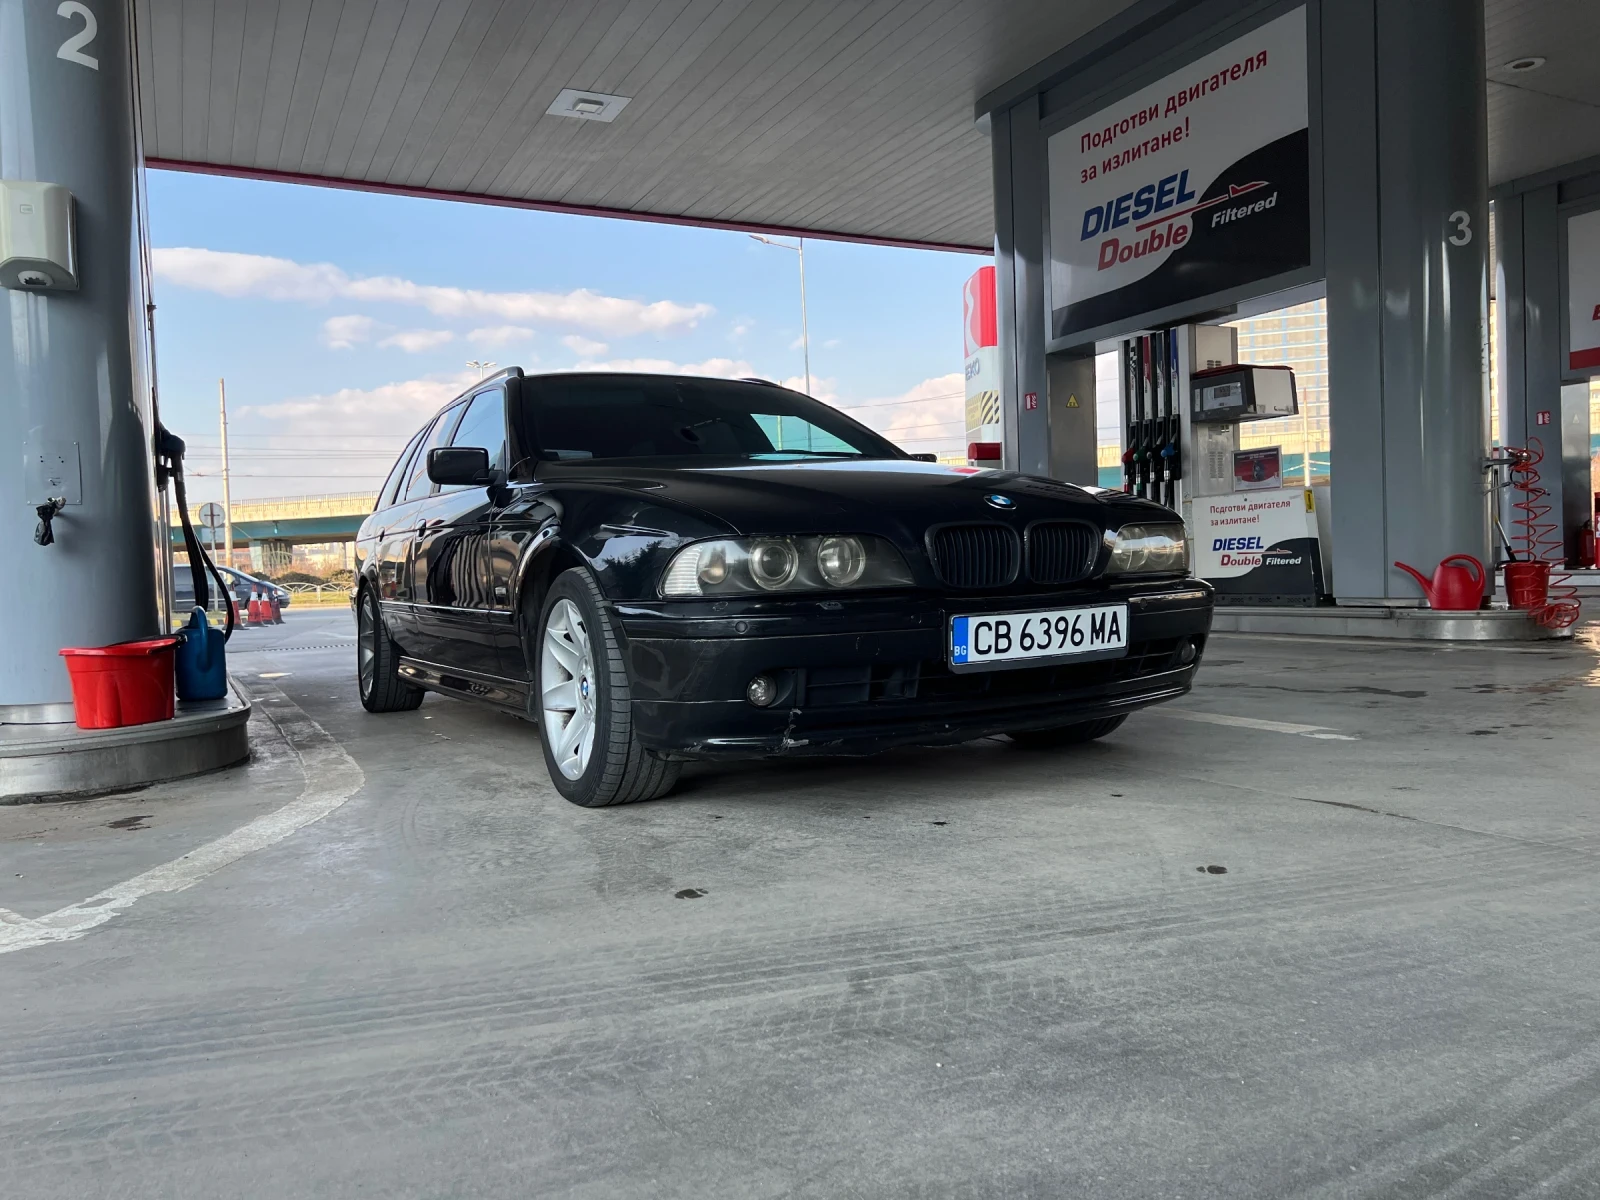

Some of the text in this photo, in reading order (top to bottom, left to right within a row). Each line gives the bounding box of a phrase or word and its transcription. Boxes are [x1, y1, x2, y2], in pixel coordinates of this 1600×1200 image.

[57, 1, 98, 70] 2
[1081, 50, 1268, 153] Подготви двигателя
[1081, 117, 1190, 184] за излитане!
[1080, 169, 1196, 241] DIESEL
[1097, 191, 1278, 271] Double Filtered
[1448, 210, 1472, 246] 3
[1220, 514, 1260, 526] излитане!
[1248, 500, 1291, 512] двигателя
[1212, 536, 1264, 551] DIESEL
[1220, 554, 1302, 566] Double Filtered
[954, 645, 967, 656] BG
[974, 611, 1121, 655] CB 6396 MA
